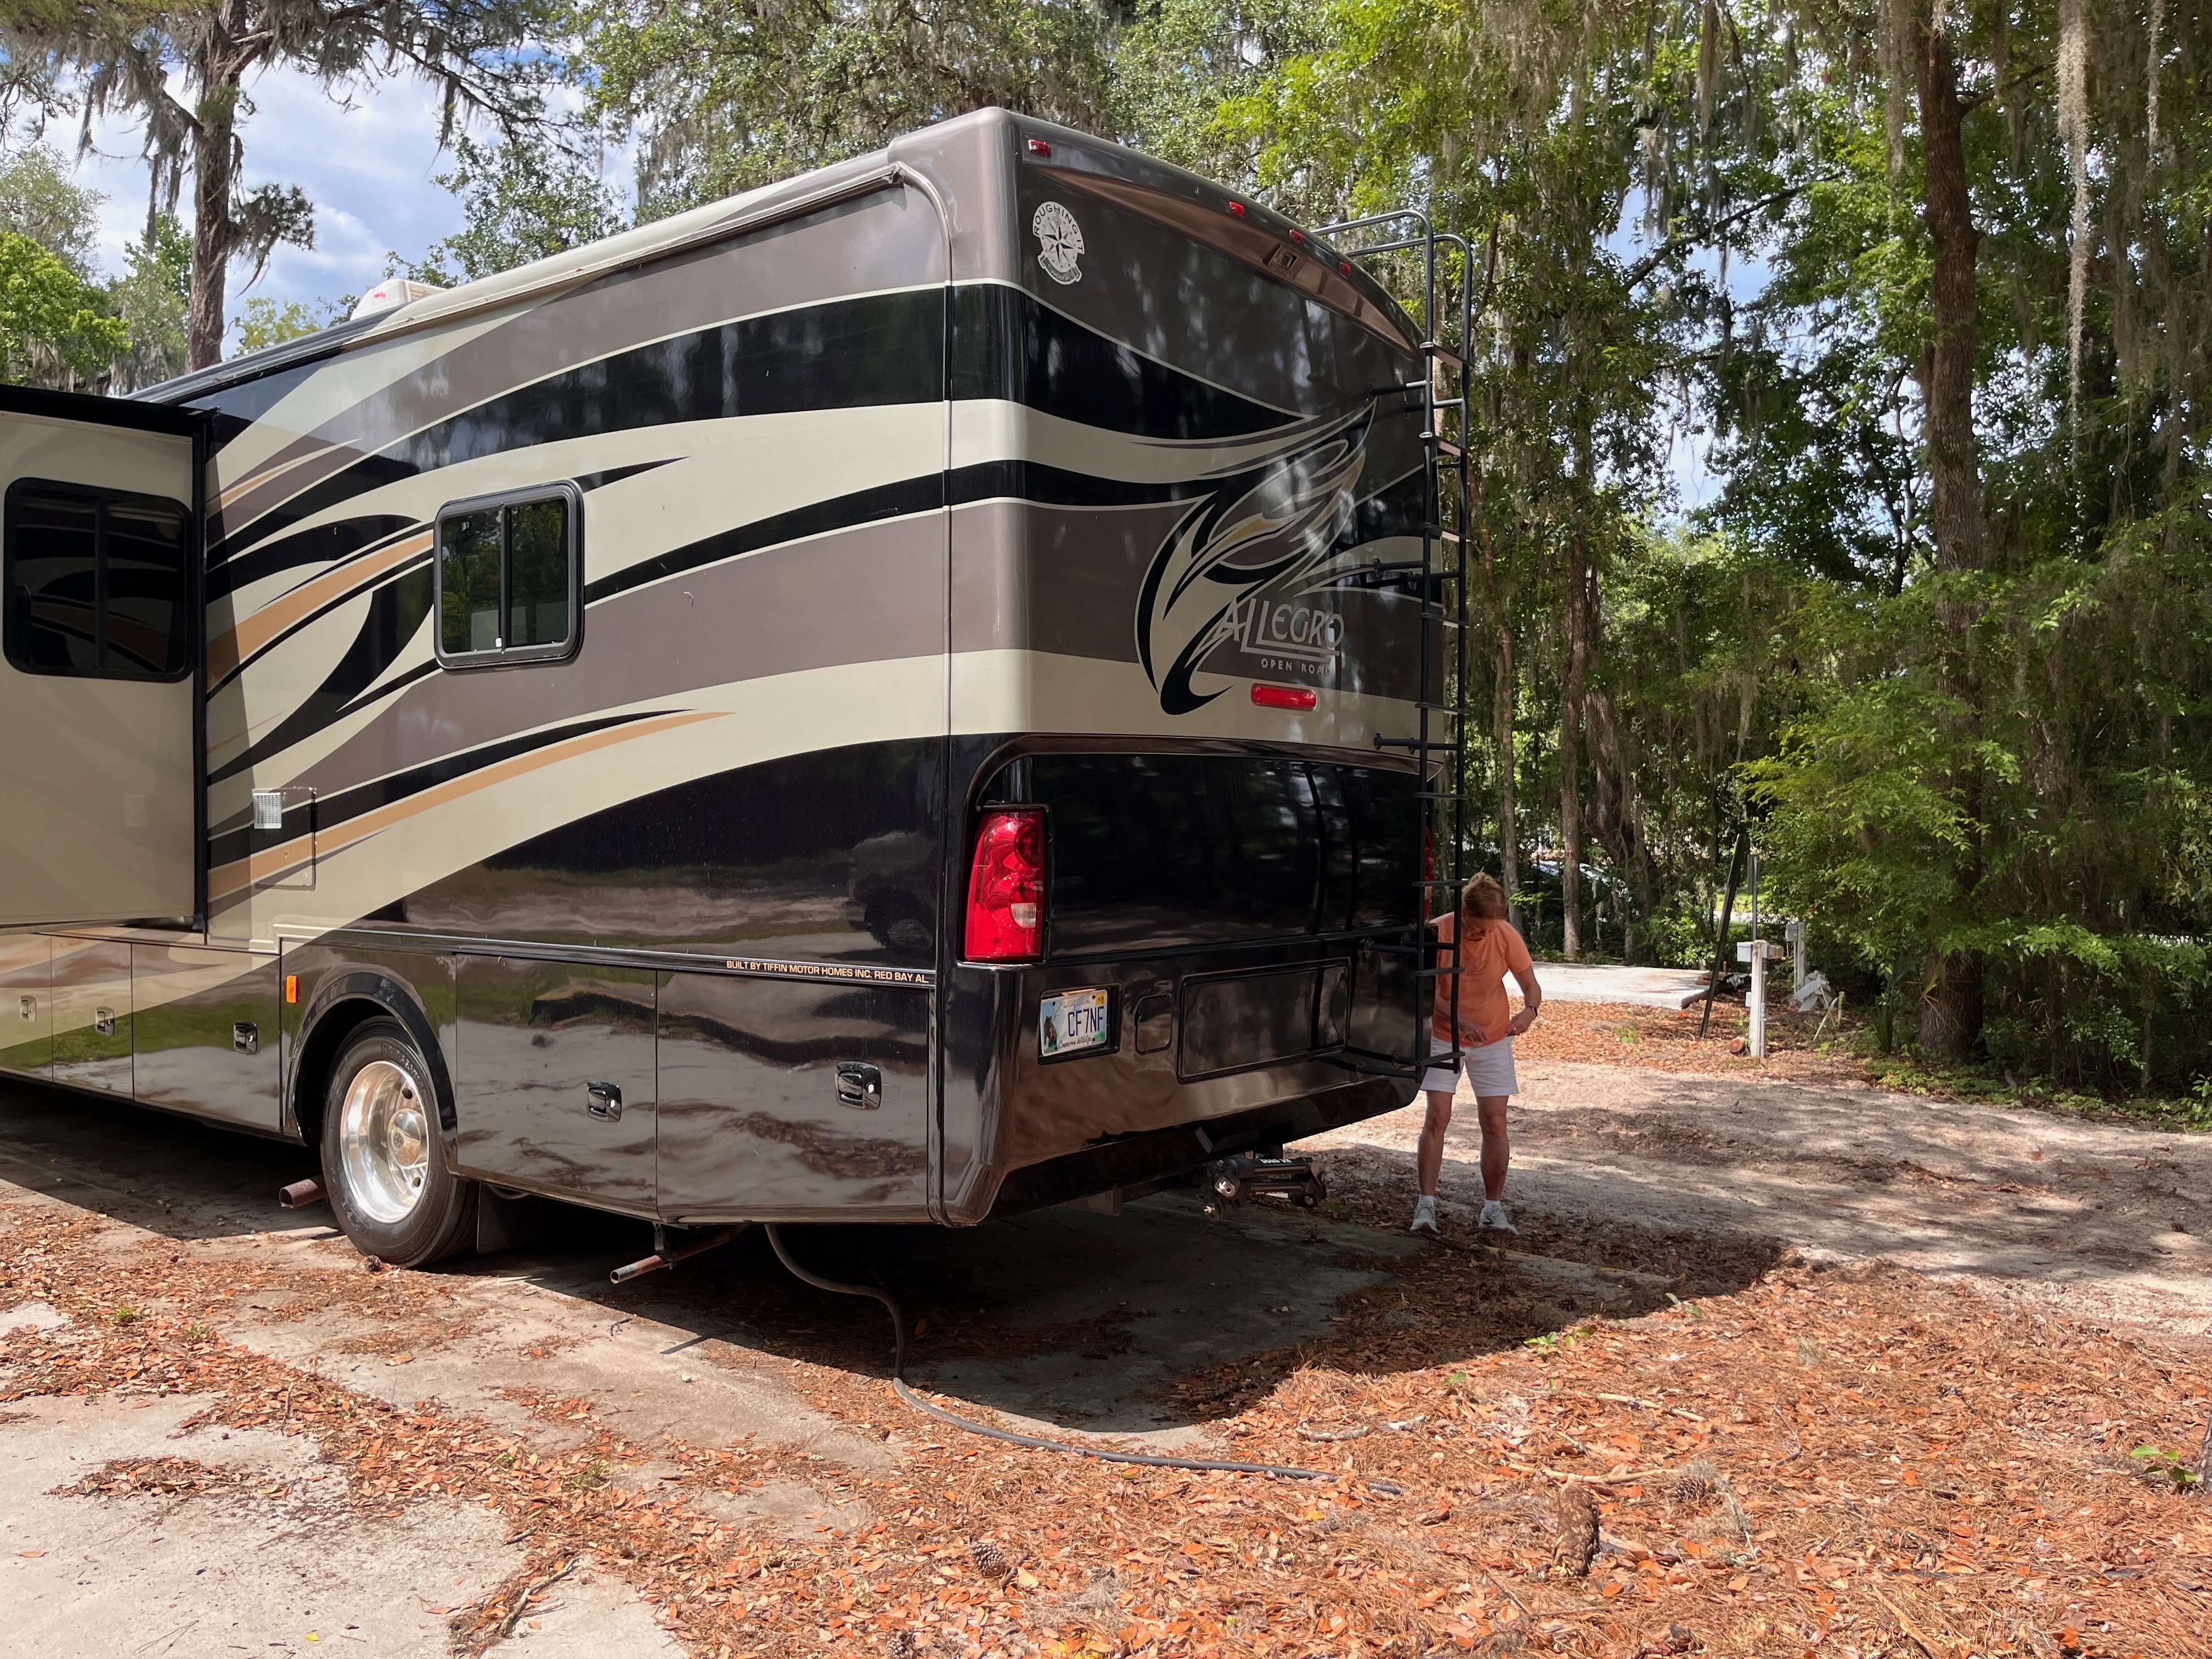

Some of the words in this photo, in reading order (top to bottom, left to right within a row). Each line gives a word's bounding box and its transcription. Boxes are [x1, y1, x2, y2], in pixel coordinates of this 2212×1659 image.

[1034, 204, 1079, 236] ROUGHING
[1076, 239, 1084, 253] IT
[1212, 596, 1344, 658] ALLEGRO
[1261, 658, 1292, 671] OPEN
[1301, 663, 1330, 675] ROAD
[726, 960, 748, 969] BUILT
[751, 962, 761, 970] BY
[763, 963, 787, 973] TIFFIN
[789, 964, 820, 975] MOTOR
[822, 967, 853, 977] HOMES
[855, 969, 872, 979] INC.
[874, 970, 893, 980] RED
[894, 972, 913, 982] BAY
[1058, 997, 1091, 1008] FLORIDA
[1068, 1006, 1104, 1037] CF7NF
